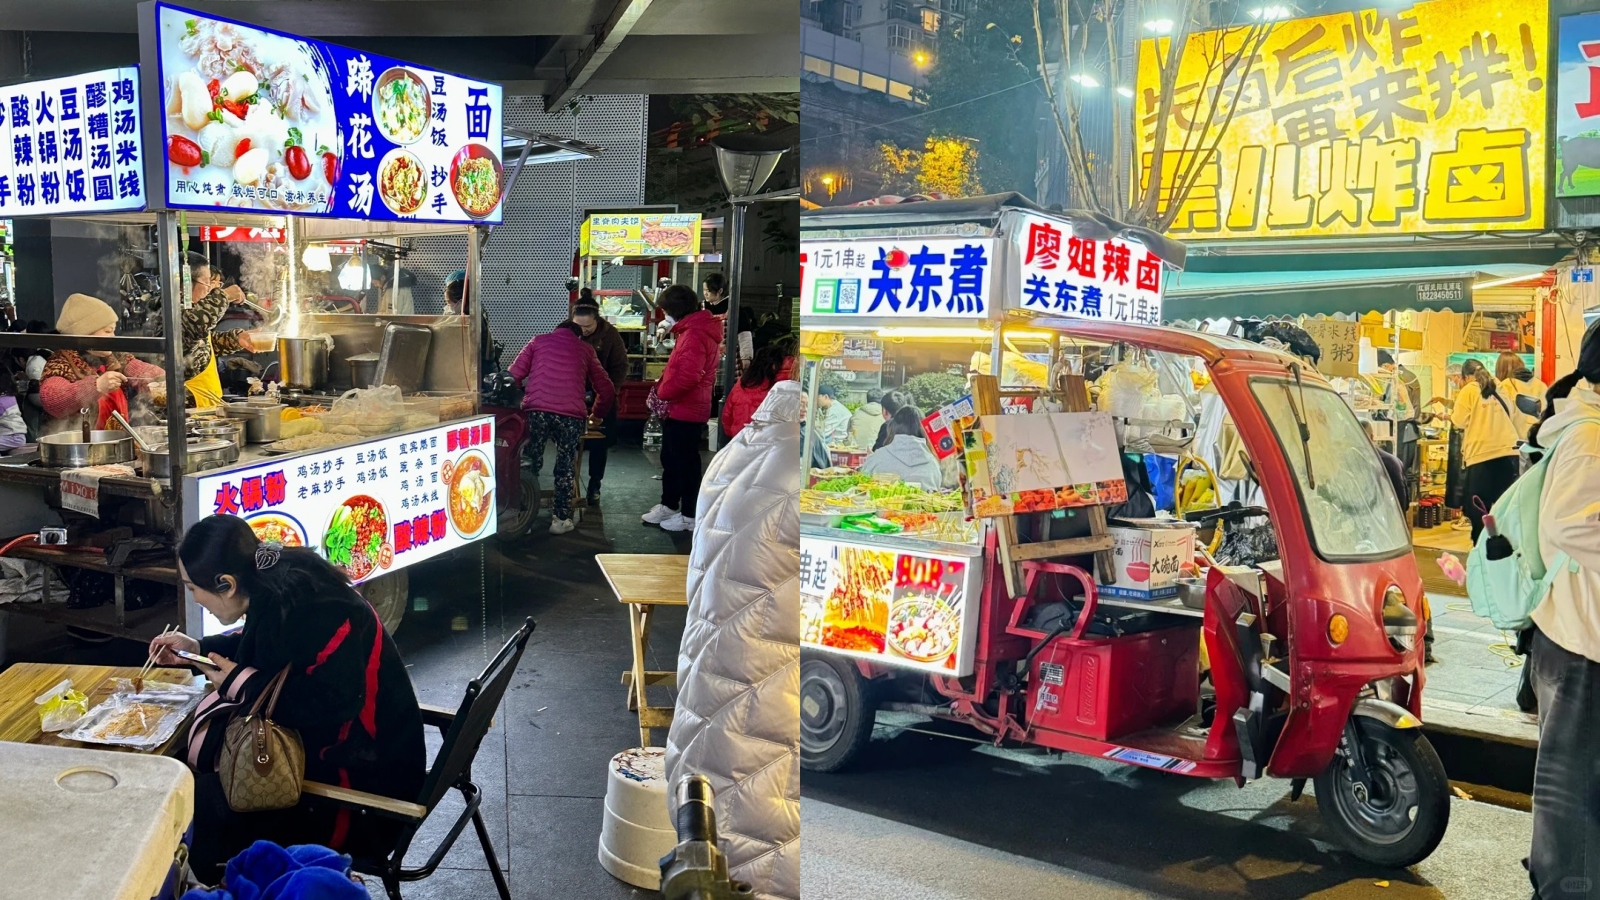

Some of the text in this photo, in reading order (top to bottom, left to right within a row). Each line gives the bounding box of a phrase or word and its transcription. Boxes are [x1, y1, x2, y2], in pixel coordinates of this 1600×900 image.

[1271, 22, 1544, 147] 再来拌!
[346, 54, 375, 216] 蹄花汤
[431, 75, 449, 147] 豆汤饭
[465, 86, 492, 143] 面
[10, 94, 36, 206] 酸辣粉
[36, 91, 60, 205] 火锅粉
[60, 87, 87, 202] 豆汤饭
[85, 81, 114, 201] 醪糟汤圆
[112, 78, 140, 199] 鸡汤米线
[175, 180, 226, 196] 用心炖煮
[232, 184, 278, 199] 软烂可口
[284, 189, 327, 204] 滋补养生
[431, 164, 449, 215] 抄手
[813, 247, 866, 269] 1元1串起
[866, 243, 988, 314] 关东煮
[1025, 222, 1161, 294] 廖姐辣卤
[1023, 273, 1160, 326] 关东煮 1元1串起
[297, 456, 345, 478] 鸡汤抄手
[355, 447, 388, 465] 豆汤饭
[356, 465, 388, 484] 鸡汤饭
[213, 469, 287, 515] 火锅粉
[297, 476, 346, 500] 老麻抄手
[400, 471, 438, 491] 鸡汤面
[401, 489, 439, 510] 鸡汤米线
[394, 507, 448, 555] 酸辣粉
[1151, 554, 1179, 574] 大碗面
